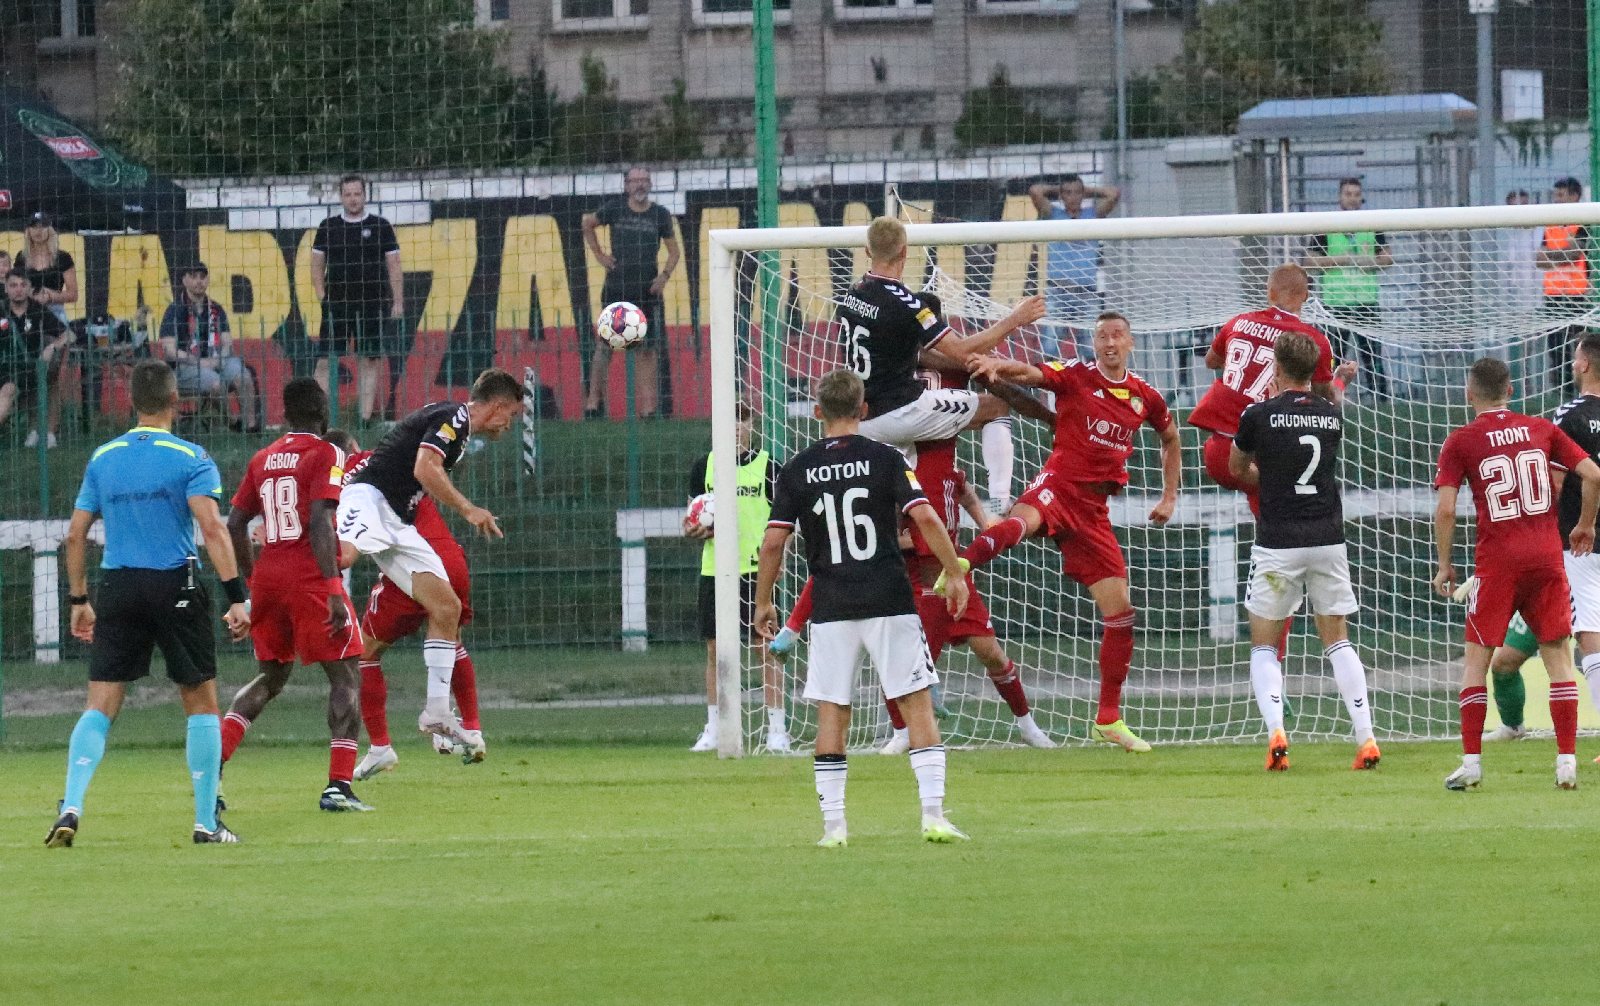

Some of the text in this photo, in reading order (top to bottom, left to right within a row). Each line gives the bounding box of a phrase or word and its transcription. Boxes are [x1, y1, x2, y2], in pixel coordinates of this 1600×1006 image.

[1232, 319, 1283, 343] HOOGENH
[1222, 338, 1275, 401] 87
[264, 453, 300, 471] AGBOR
[1294, 434, 1322, 495] 2
[1486, 426, 1531, 448] TRONT
[806, 460, 871, 484] KOTON
[1479, 449, 1552, 522] 20
[260, 476, 303, 543] 18
[812, 487, 877, 564] 16
